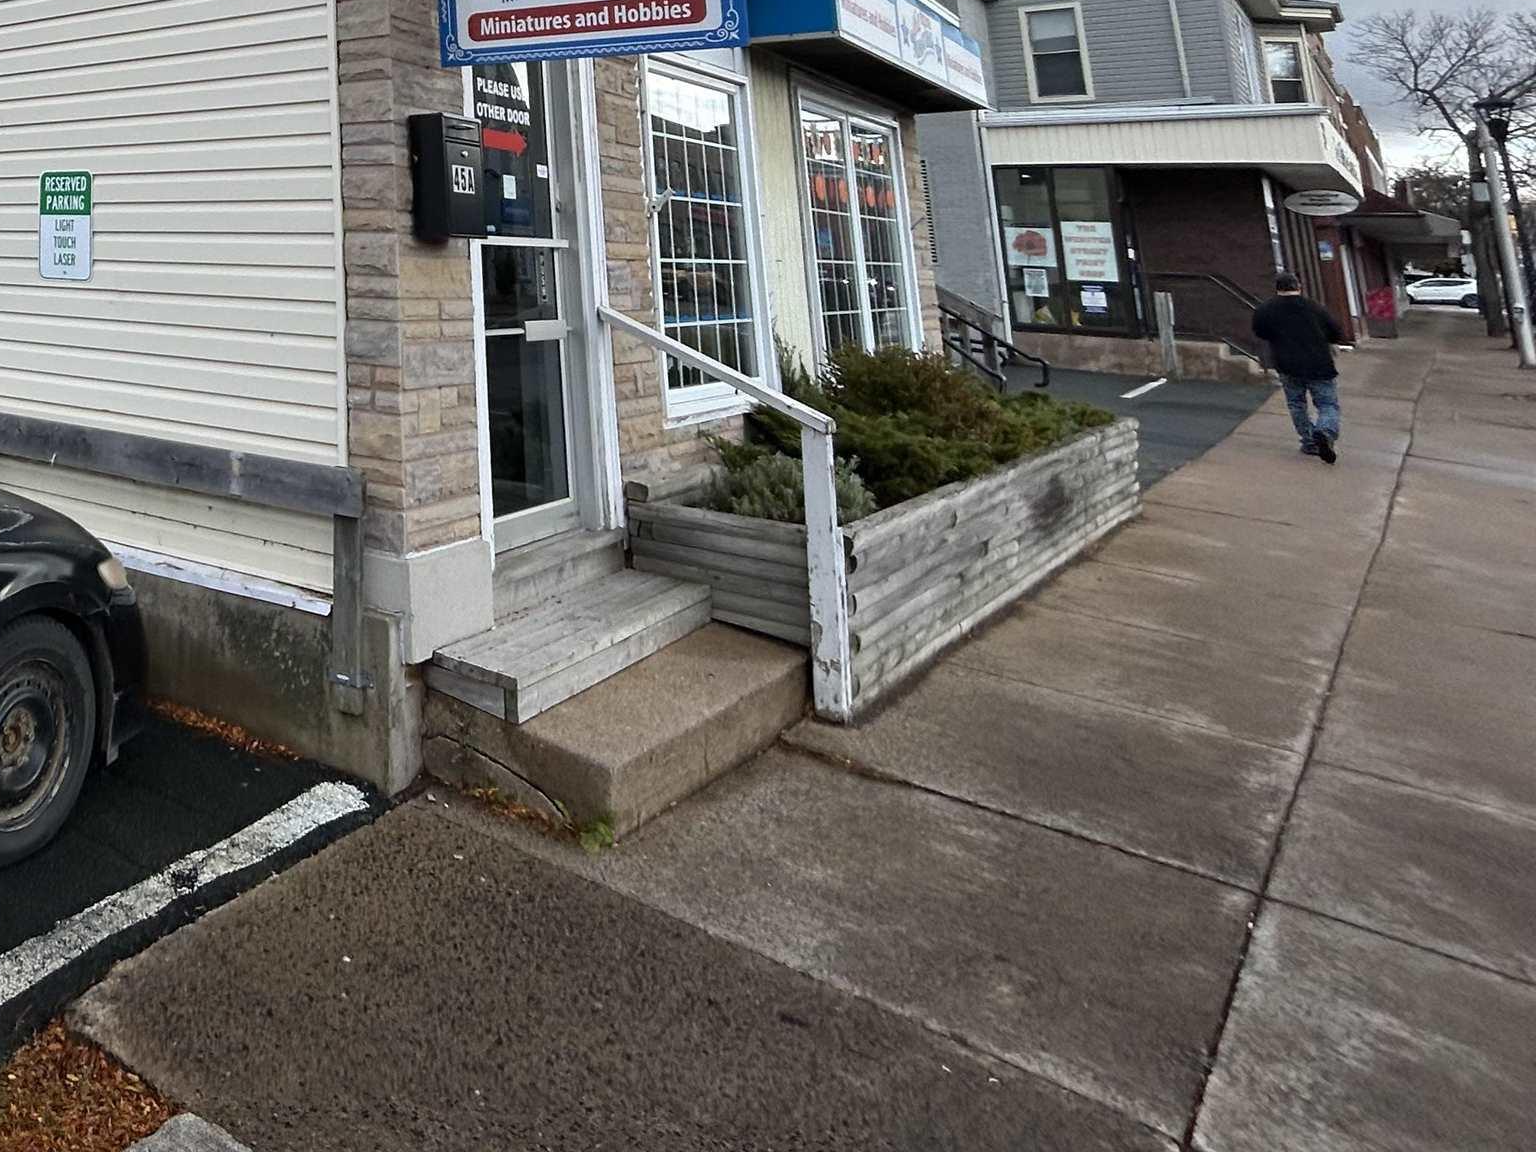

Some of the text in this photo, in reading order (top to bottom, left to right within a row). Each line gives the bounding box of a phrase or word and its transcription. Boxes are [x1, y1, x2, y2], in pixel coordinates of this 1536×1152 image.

[480, 0, 692, 36] Miniatures and Hobbies
[476, 77, 510, 98] PLEASE
[476, 102, 531, 126] OTHER DOOR
[45, 176, 87, 192] RESERVED
[454, 166, 475, 192] 45A
[46, 194, 85, 211] PARKING
[55, 219, 75, 232] LIGHT
[53, 236, 76, 249] TOUCH
[53, 253, 76, 266] LASER
